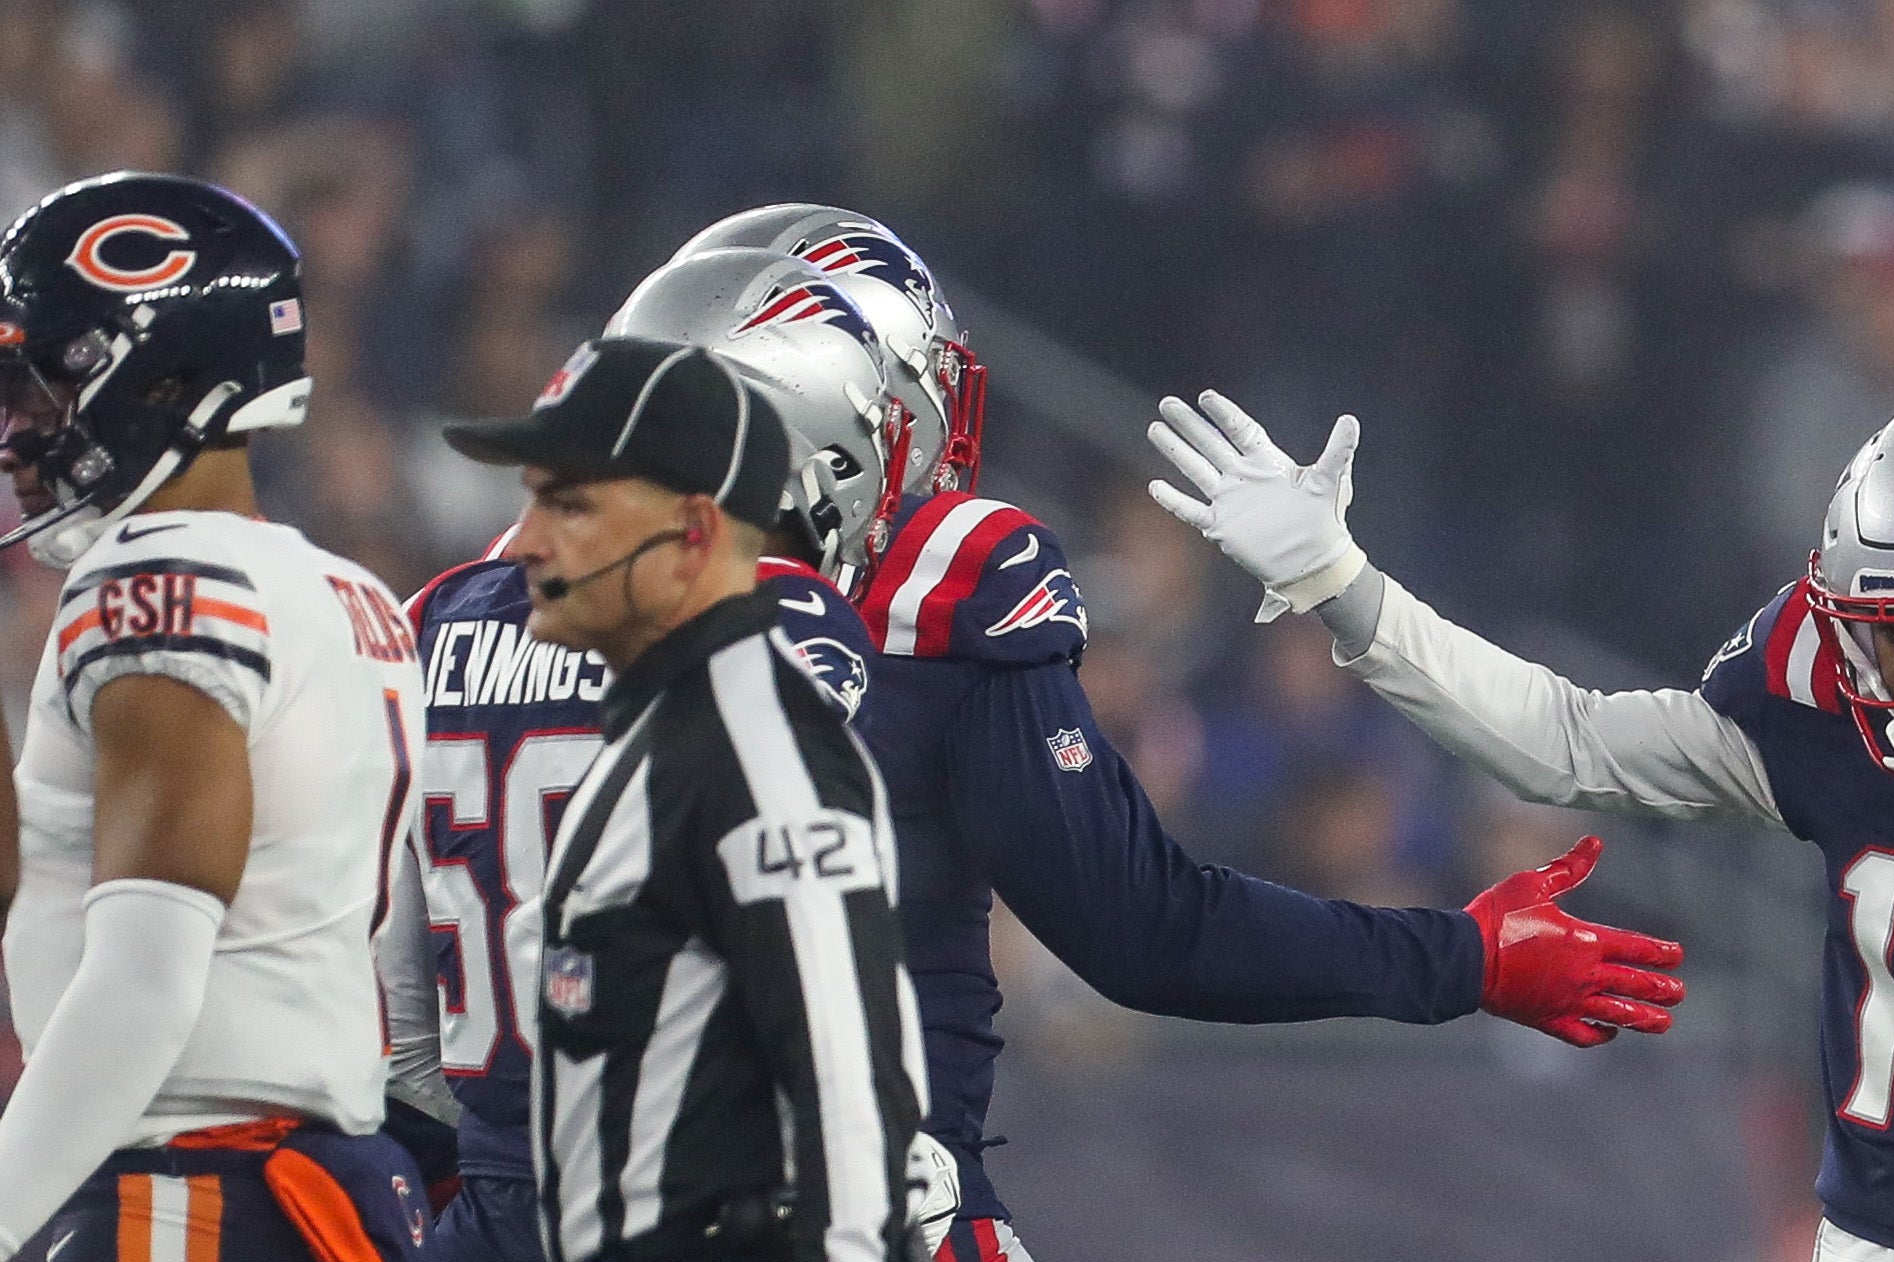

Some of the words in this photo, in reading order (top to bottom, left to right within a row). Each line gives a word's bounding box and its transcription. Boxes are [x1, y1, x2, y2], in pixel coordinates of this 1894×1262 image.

[98, 572, 197, 641] GSH
[424, 619, 618, 708] JENNINGS
[1058, 745, 1088, 766] NFL
[756, 821, 857, 880] 42
